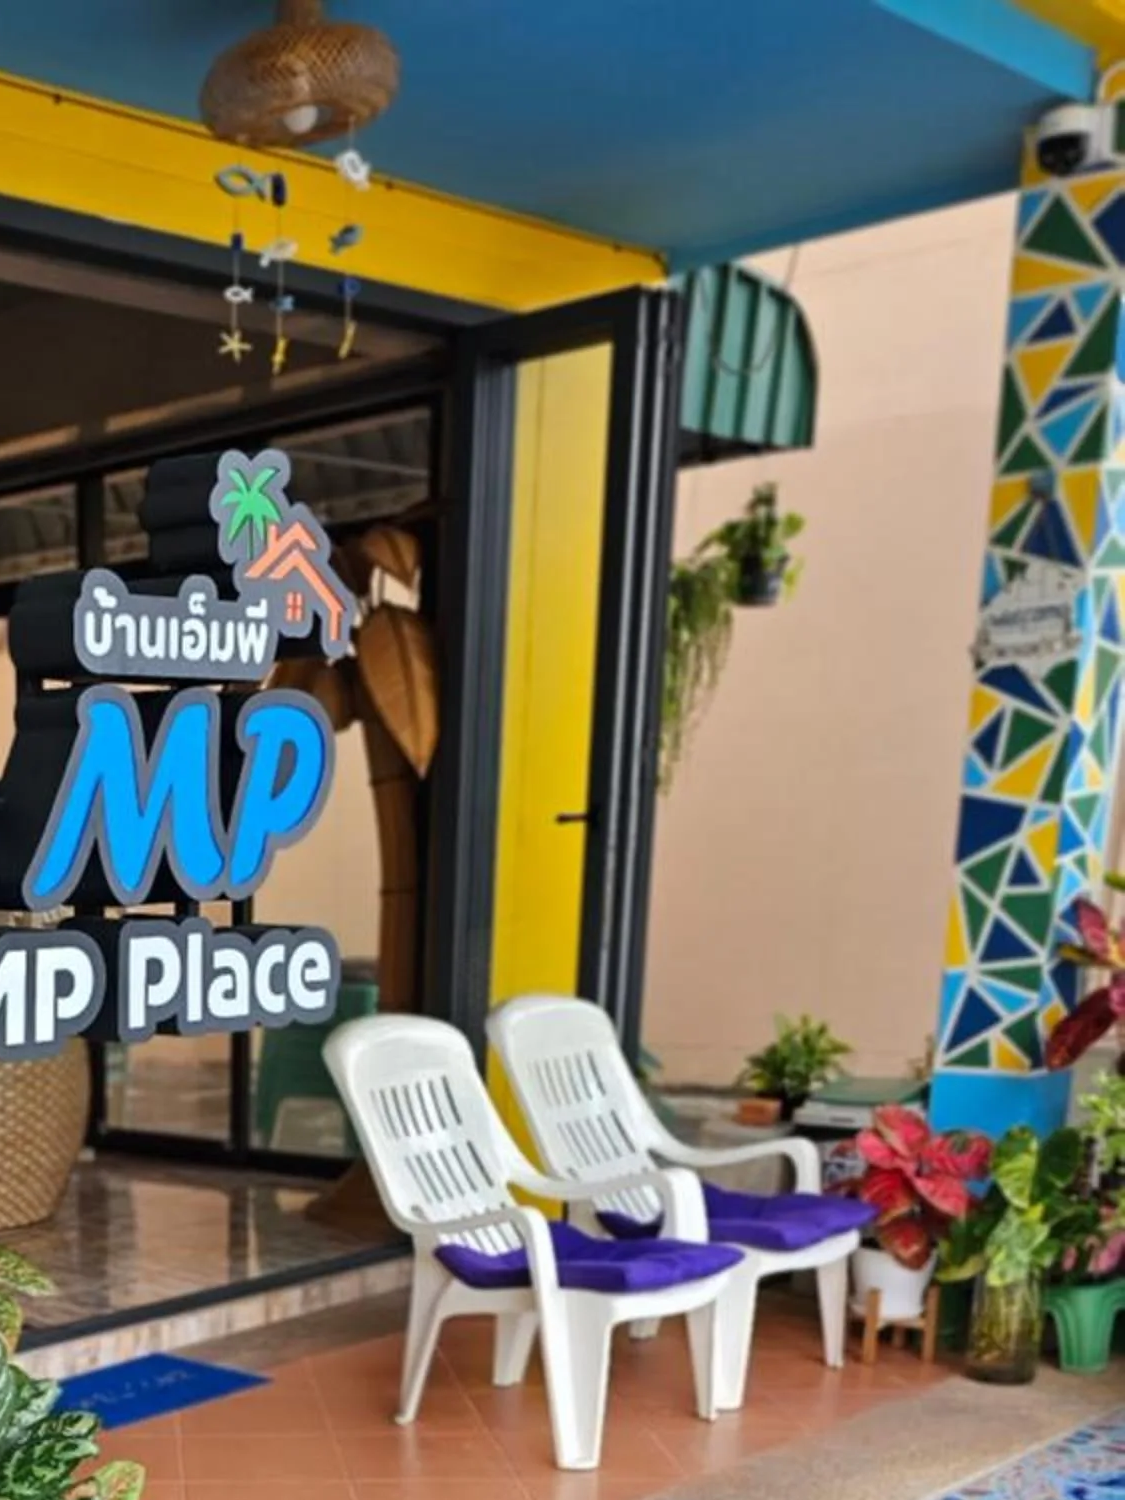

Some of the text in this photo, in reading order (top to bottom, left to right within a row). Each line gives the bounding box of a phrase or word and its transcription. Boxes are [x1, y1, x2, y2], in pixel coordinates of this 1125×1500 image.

[83, 585, 270, 666] บ้านเอ็มพี
[29, 698, 329, 900] MP
[126, 932, 333, 1031] Place
